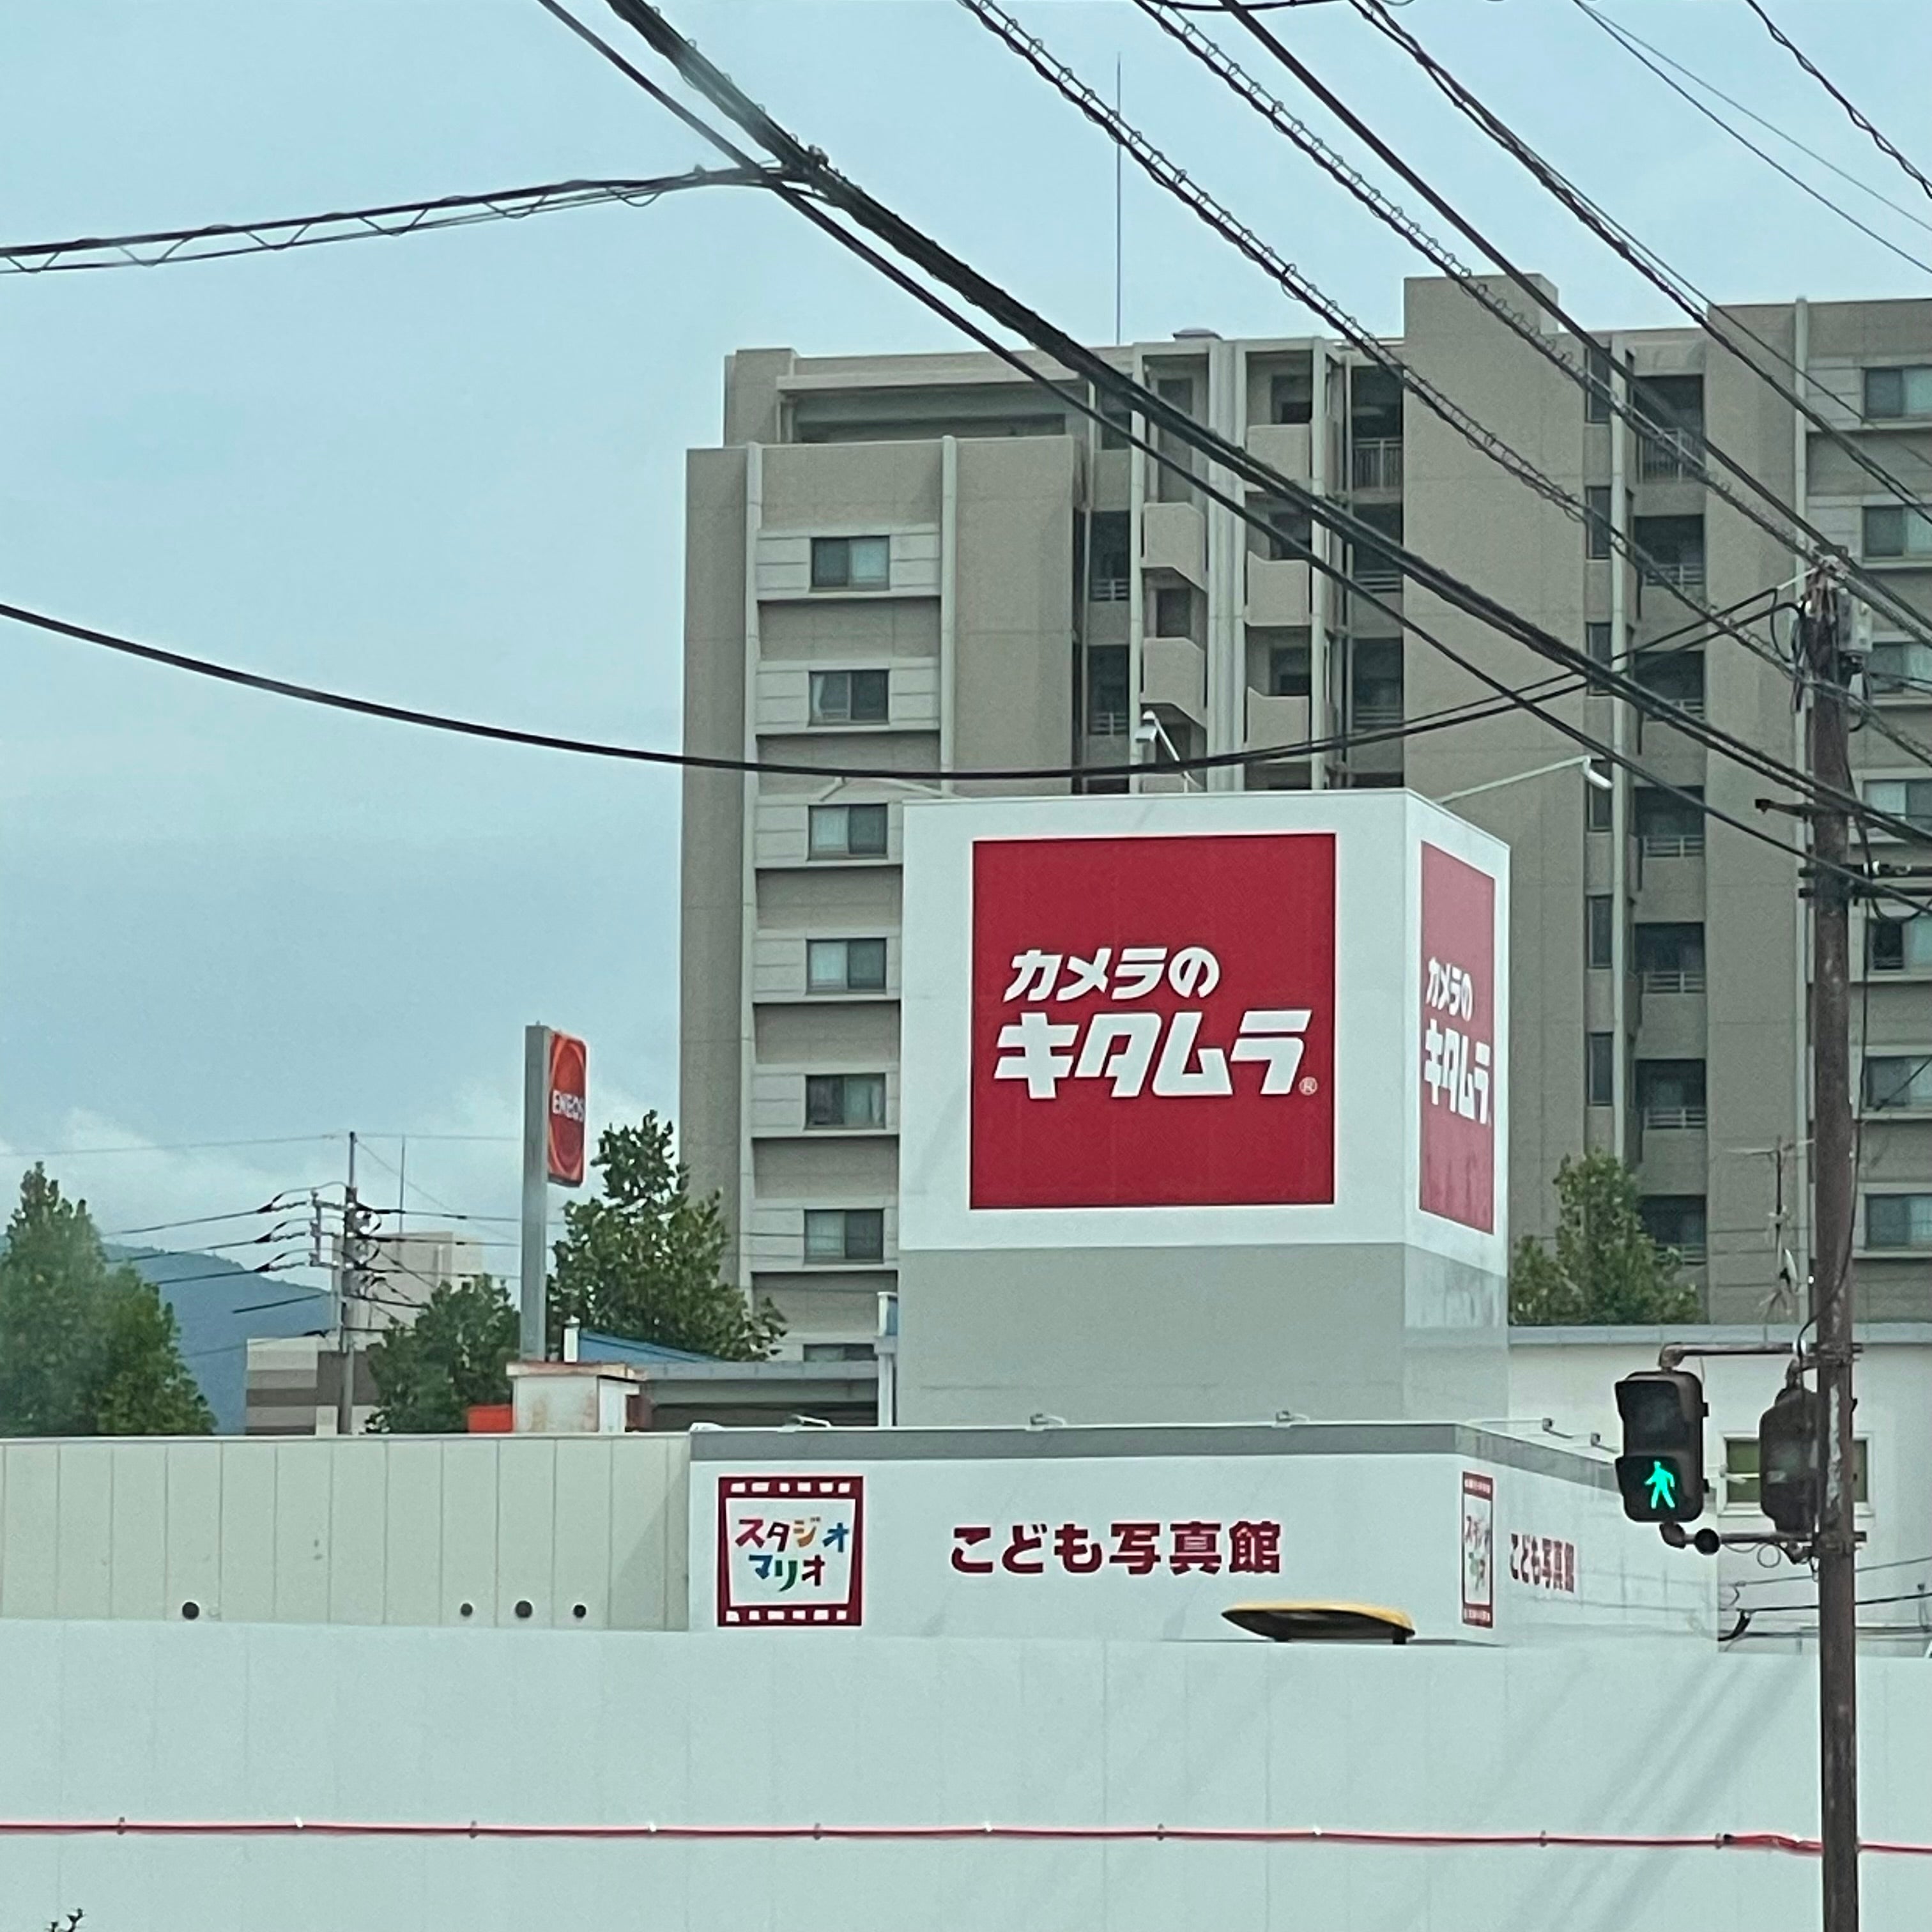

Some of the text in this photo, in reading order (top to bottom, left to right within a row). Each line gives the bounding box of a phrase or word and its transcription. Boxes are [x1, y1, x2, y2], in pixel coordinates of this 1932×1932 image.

[1003, 947, 1220, 1002] カメラの
[1426, 957, 1473, 1022] カメラの
[735, 1517, 849, 1552] スタジオ
[951, 1521, 1280, 1575] こども写真館
[748, 1554, 825, 1591] マリオ
